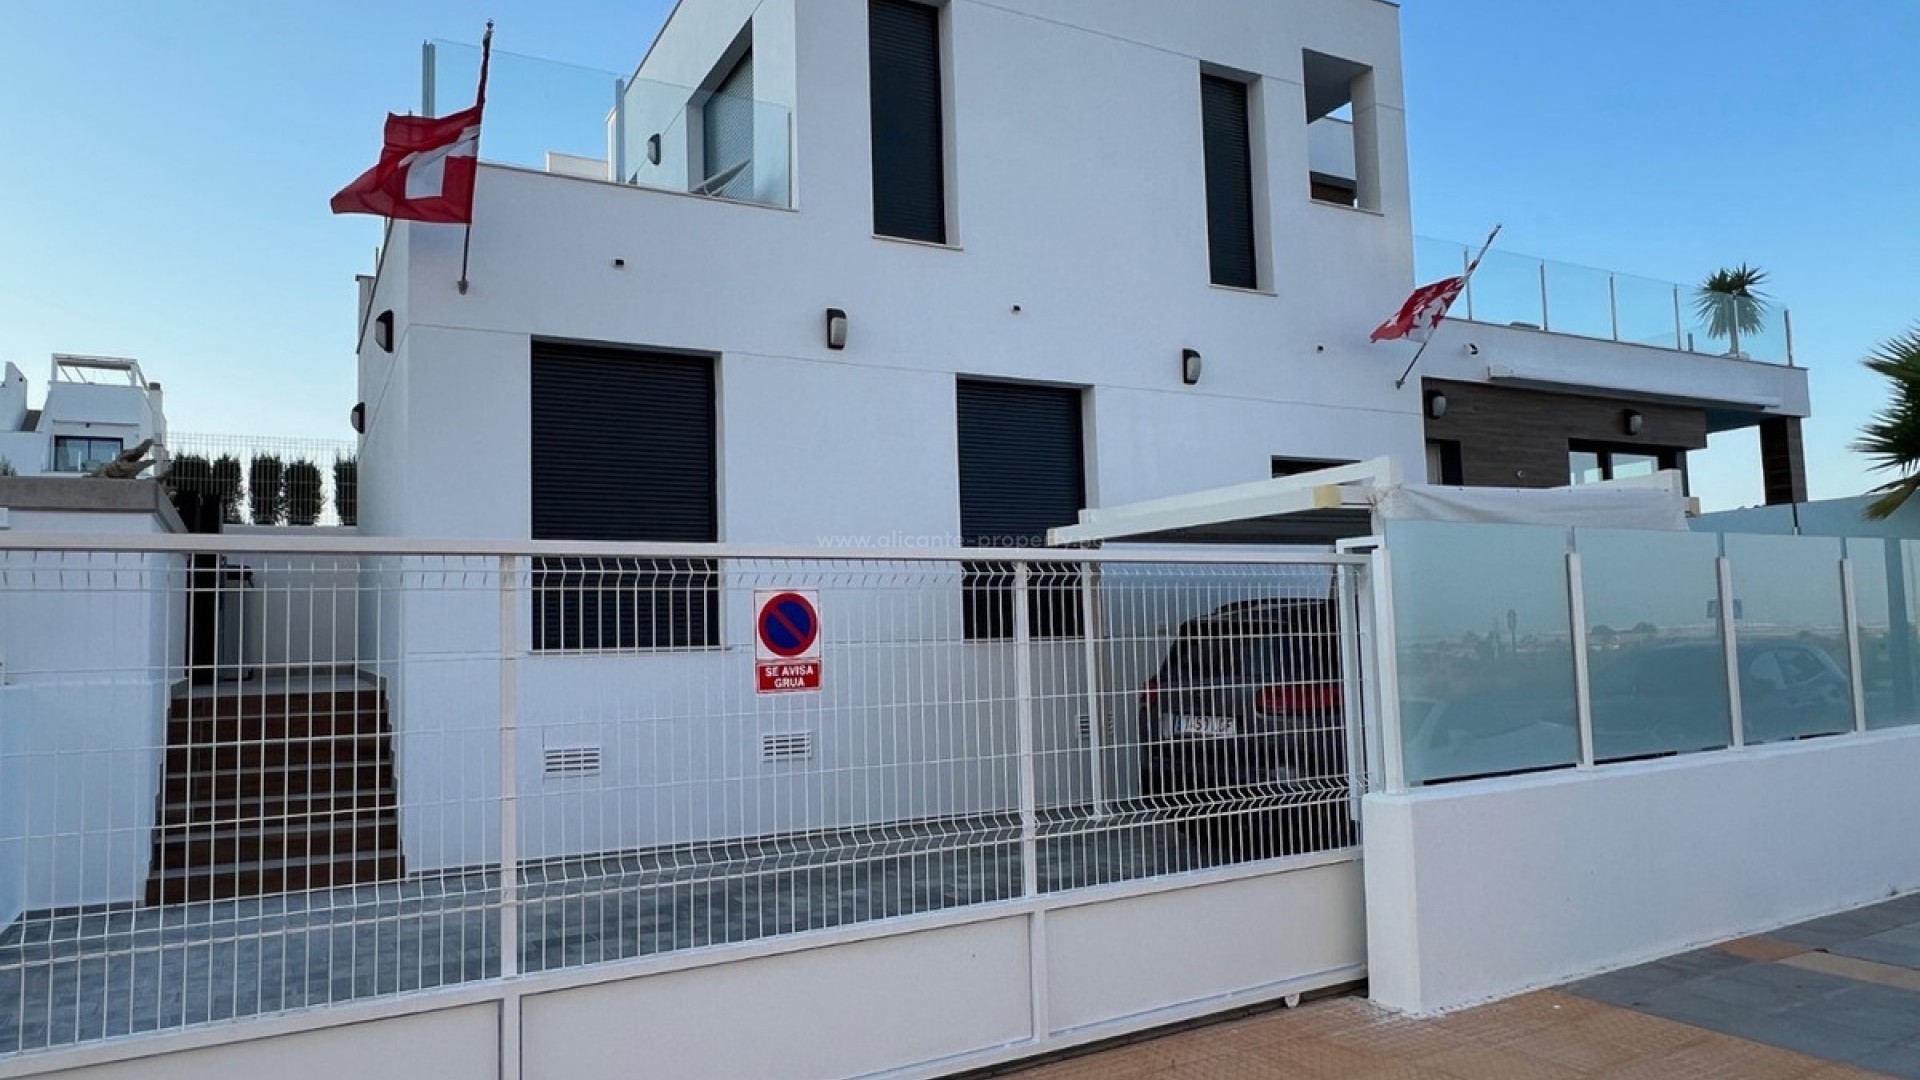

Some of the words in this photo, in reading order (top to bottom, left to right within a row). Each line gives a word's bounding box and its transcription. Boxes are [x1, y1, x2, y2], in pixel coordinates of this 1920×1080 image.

[765, 666, 779, 677] SE
[782, 665, 814, 676] AVISA
[774, 677, 806, 688] GRUA
